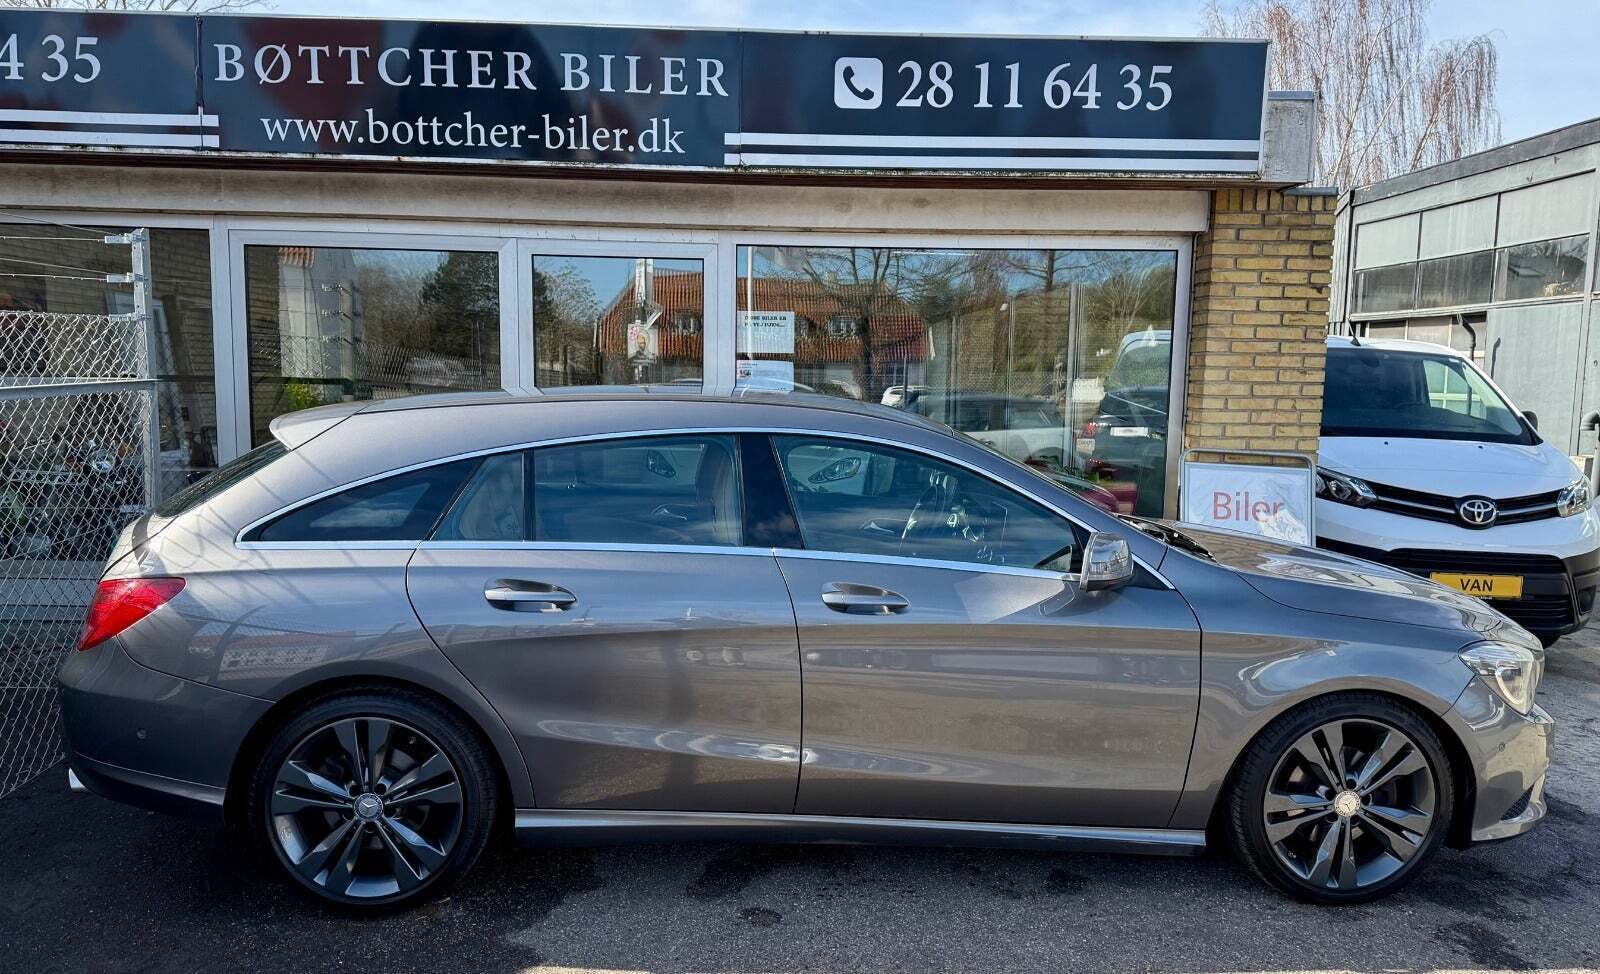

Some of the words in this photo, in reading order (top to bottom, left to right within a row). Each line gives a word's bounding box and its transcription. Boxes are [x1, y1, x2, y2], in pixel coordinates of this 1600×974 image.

[41, 34, 101, 84] 35
[213, 42, 537, 90] BØTTCHER
[560, 53, 729, 97] BILER
[896, 60, 954, 108] 28
[973, 62, 1023, 108] 11
[1043, 62, 1102, 109] 64
[1116, 64, 1173, 111] 35
[259, 107, 686, 154] www.bottcher-biler.dk
[1212, 491, 1284, 524] Biler
[1459, 578, 1494, 592] VAN
